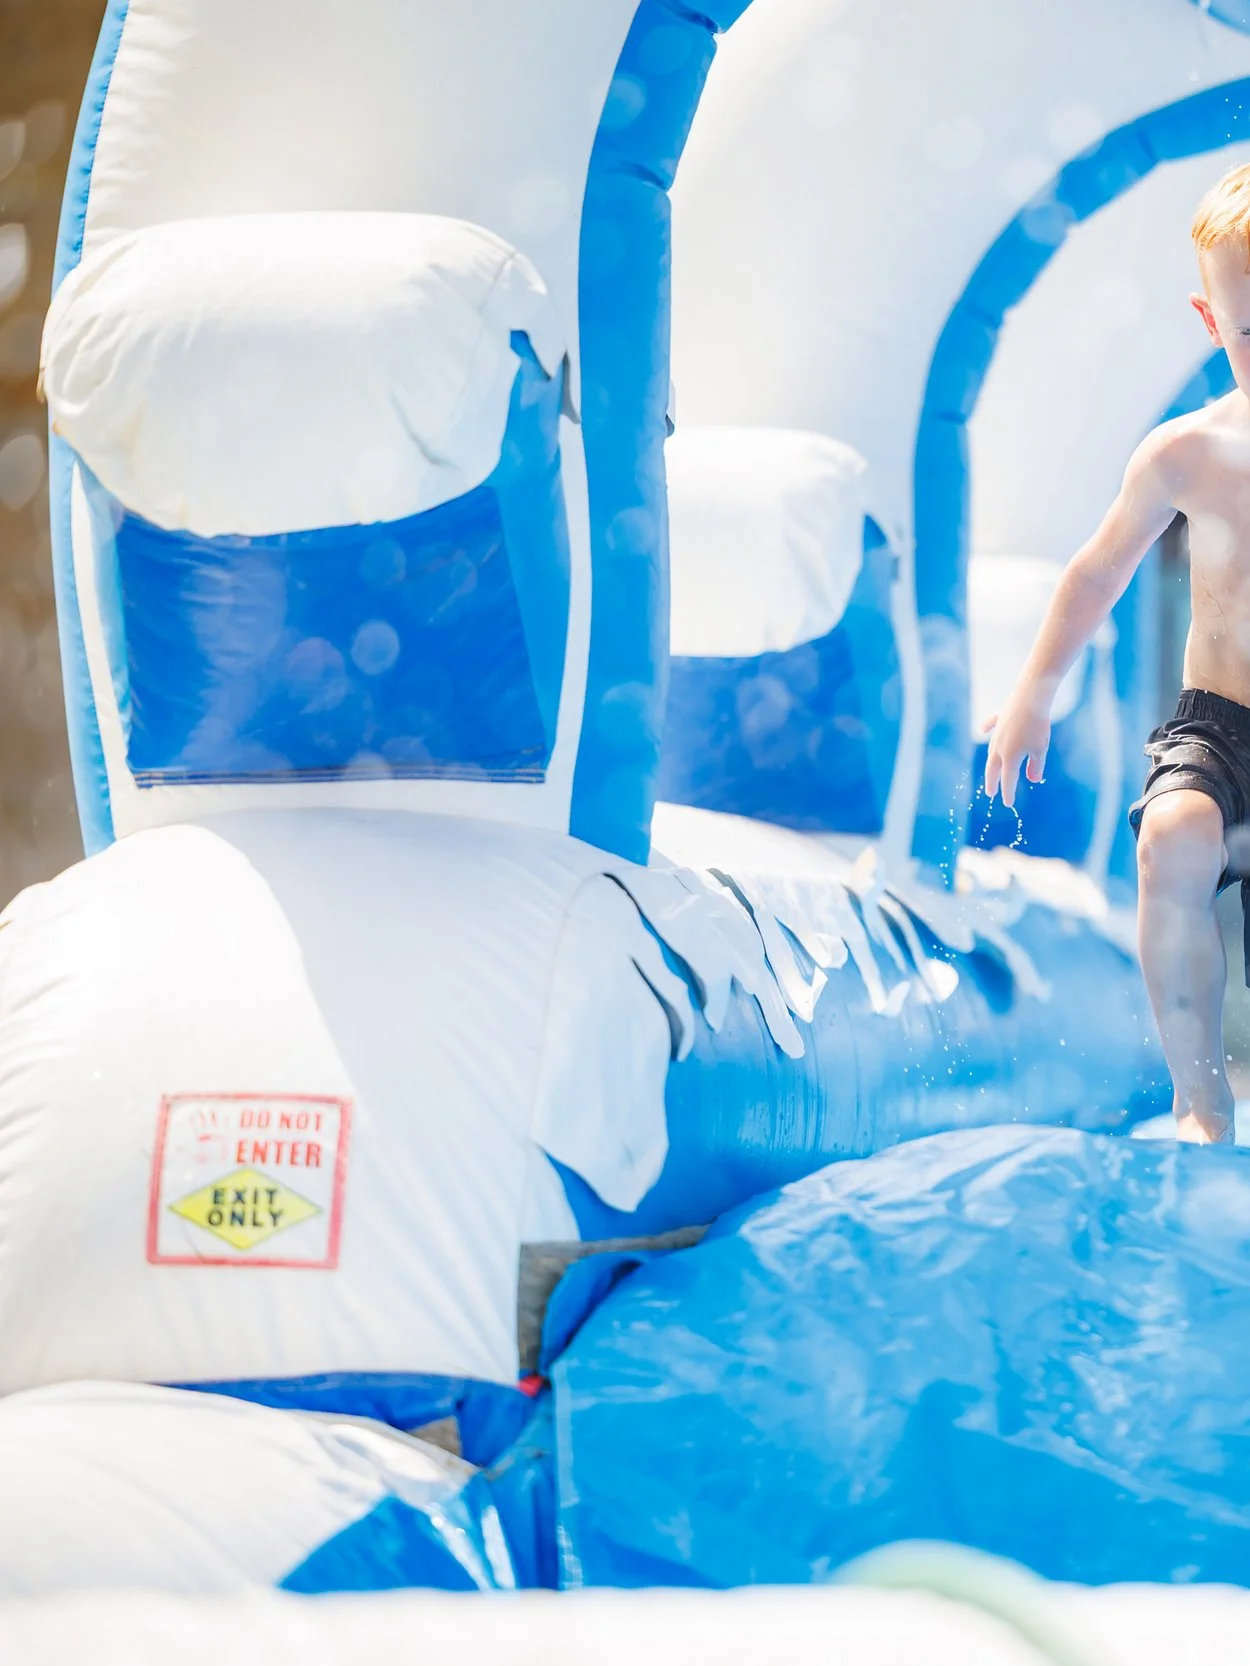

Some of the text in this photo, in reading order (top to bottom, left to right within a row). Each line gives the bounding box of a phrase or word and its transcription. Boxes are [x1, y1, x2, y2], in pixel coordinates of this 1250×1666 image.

[239, 1109, 323, 1132] DO NOT
[236, 1139, 322, 1168] ENTER
[212, 1187, 278, 1205] EXIT
[207, 1209, 283, 1227] ONLY
